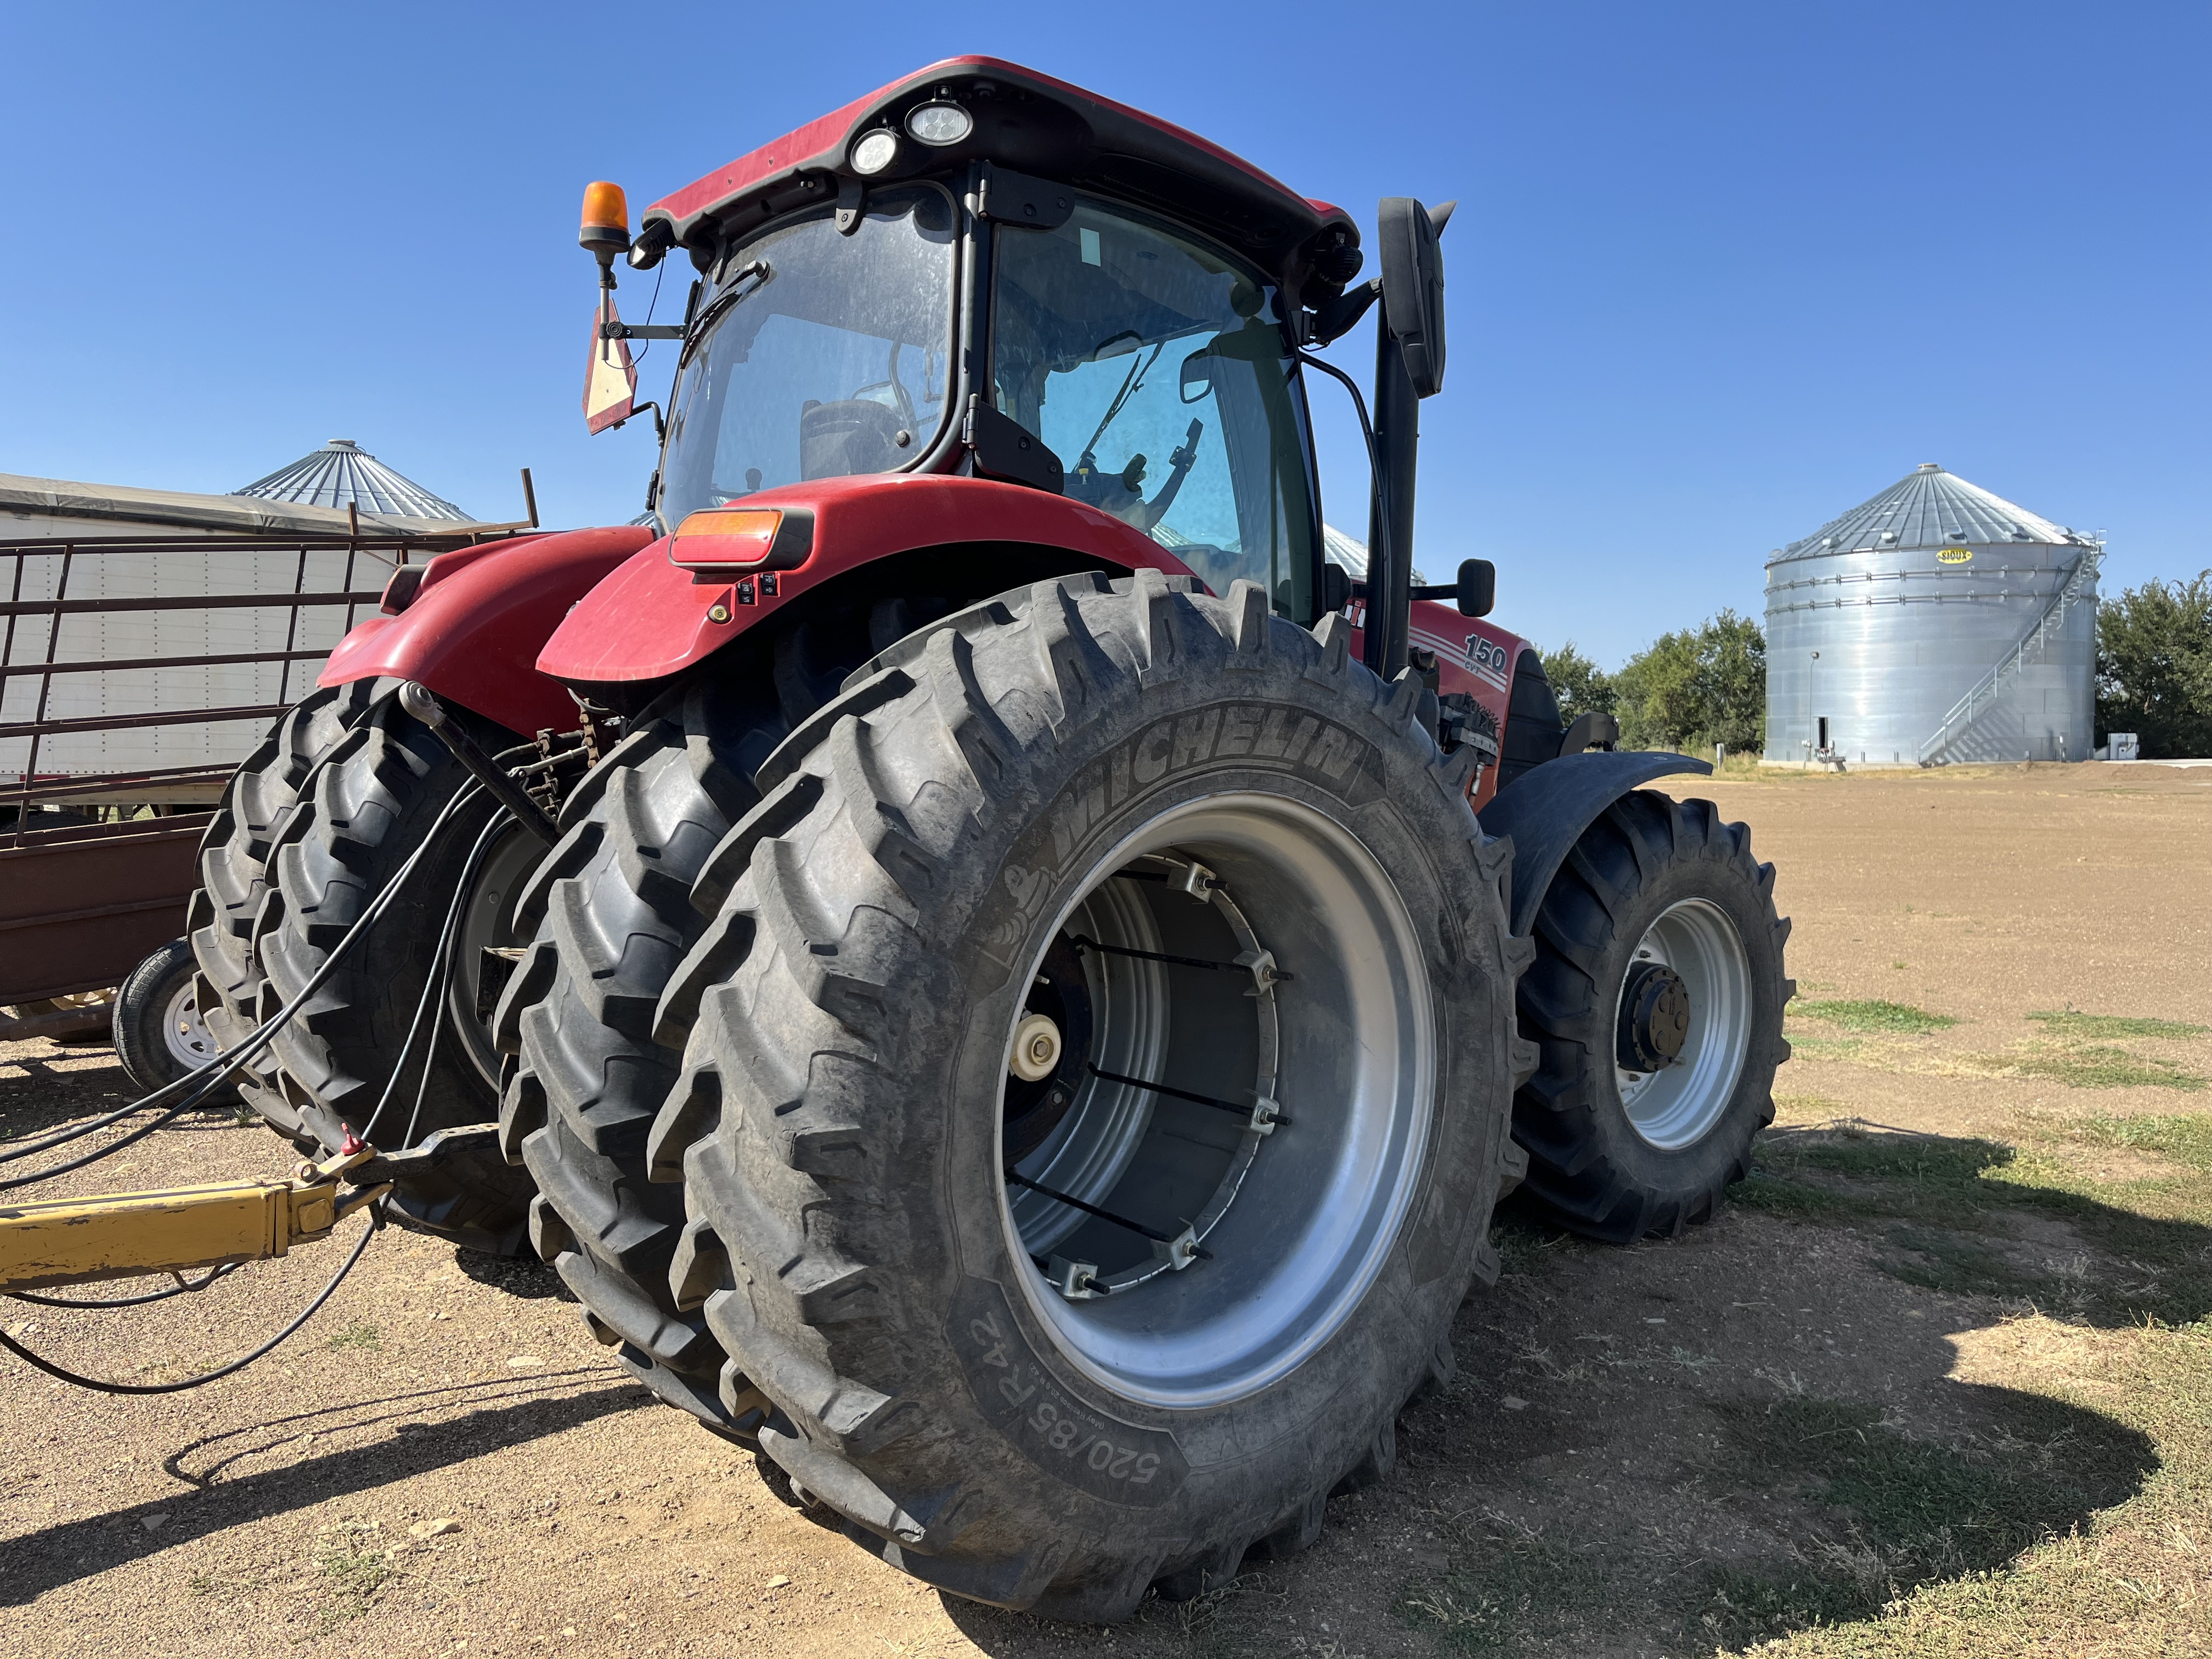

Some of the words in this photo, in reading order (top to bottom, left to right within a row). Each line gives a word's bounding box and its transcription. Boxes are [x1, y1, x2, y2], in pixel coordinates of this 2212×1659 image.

[1942, 550, 1966, 561] SIOUX
[1464, 633, 1506, 673] 150
[1465, 661, 1481, 674] CVT
[1049, 706, 1364, 863] MICHELIN
[1028, 1402, 1161, 1484] 520/85
